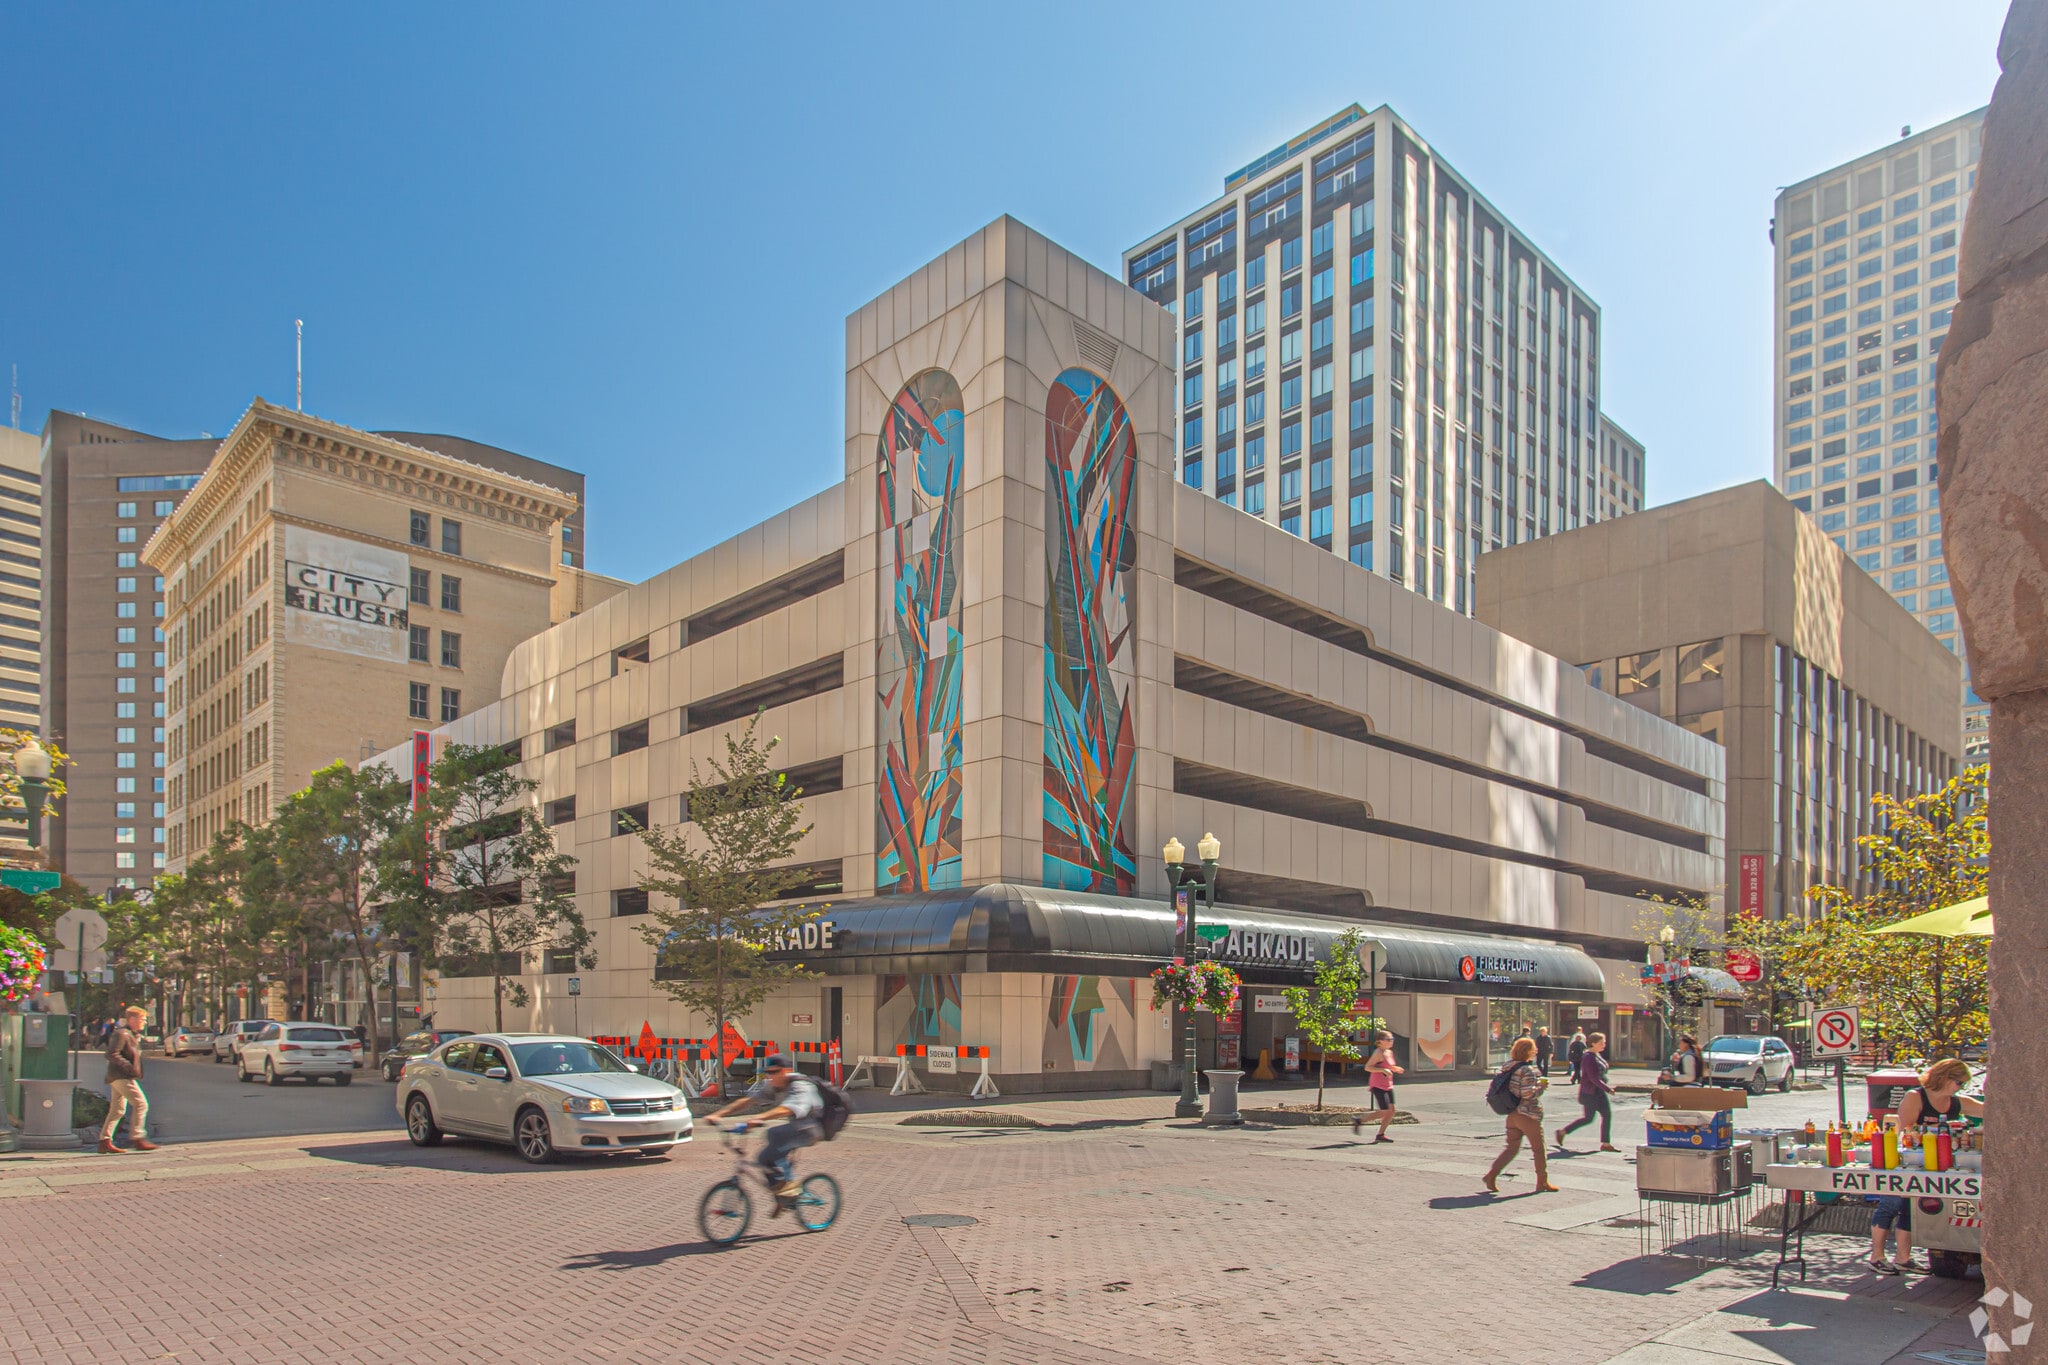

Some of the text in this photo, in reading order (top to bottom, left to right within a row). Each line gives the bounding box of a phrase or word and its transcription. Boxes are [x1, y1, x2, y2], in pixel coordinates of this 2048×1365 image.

[298, 568, 396, 604] CITY
[297, 587, 397, 627] TRUST
[1479, 971, 1503, 982] Cannabis
[929, 1050, 954, 1058] SIDEWALK
[1832, 1172, 1980, 1196] FAT FRANKS
